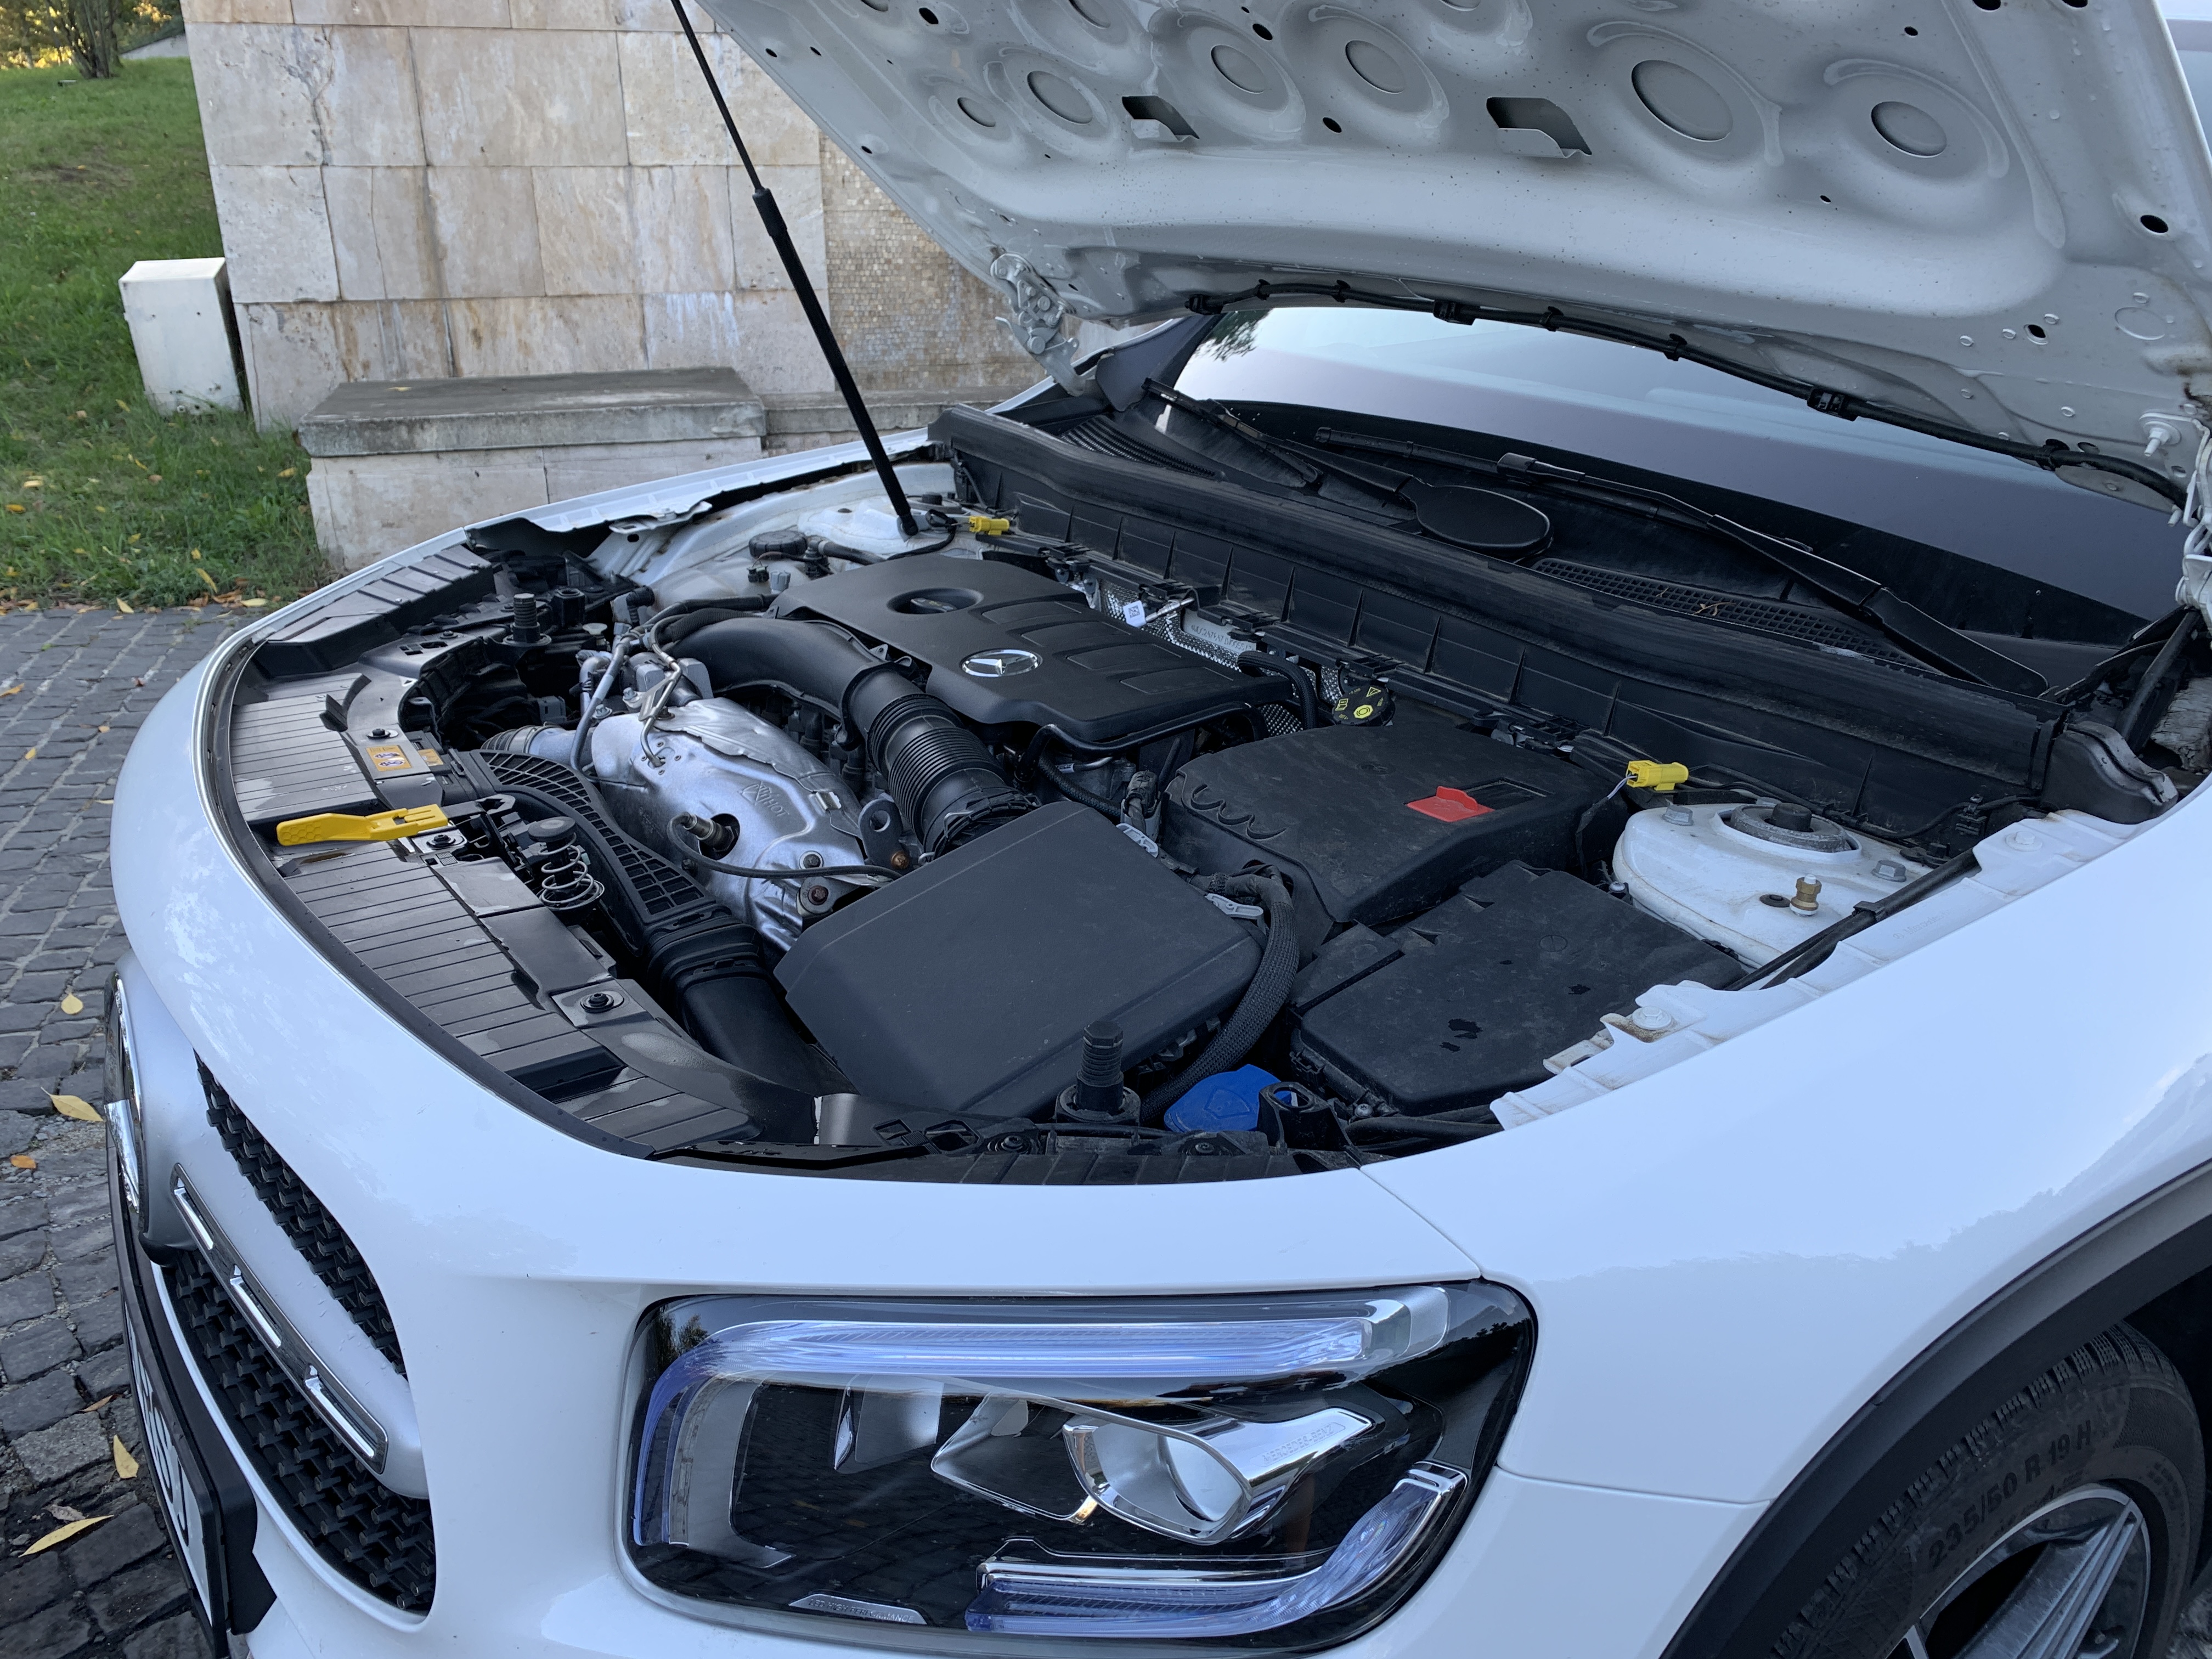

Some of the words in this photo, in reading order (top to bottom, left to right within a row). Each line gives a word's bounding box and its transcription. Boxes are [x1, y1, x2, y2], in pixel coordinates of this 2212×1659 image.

[763, 799, 790, 817] HOT
[1262, 1425, 1334, 1464] MERCEDES-BENZ
[1928, 1472, 2018, 1571] 235/50
[2024, 1453, 2042, 1485] R
[2049, 1434, 2070, 1466] 19
[2076, 1420, 2092, 1451] H
[809, 1598, 826, 1608] LED
[827, 1602, 849, 1612] HIGH
[849, 1606, 915, 1623] PERFORMANCE
